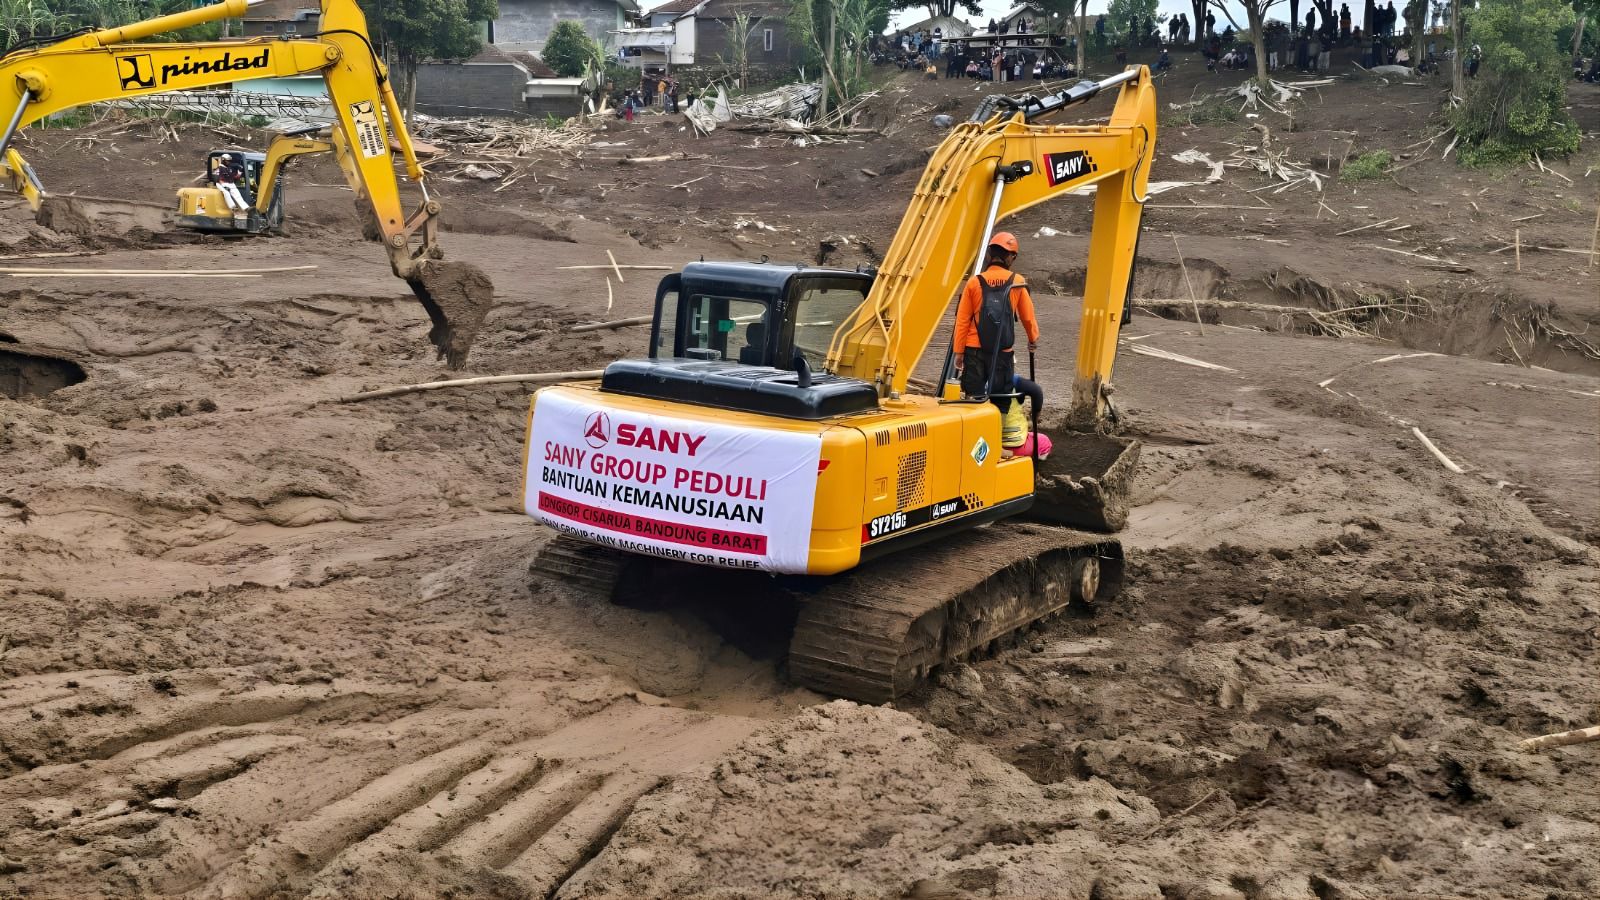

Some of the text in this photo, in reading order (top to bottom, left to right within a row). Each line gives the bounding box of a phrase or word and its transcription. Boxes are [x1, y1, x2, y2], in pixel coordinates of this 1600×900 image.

[161, 48, 270, 85] pindad
[1056, 155, 1084, 180] SANY
[616, 423, 706, 457] SANY
[544, 440, 767, 501] SANY GROUP PEDULI
[542, 465, 764, 524] BANTUAN KEMANUSIAAN
[940, 501, 958, 515] SANY
[540, 495, 761, 551] LONGSOR CISARUA BANDUNG BARAT
[560, 523, 589, 538] GROUP
[619, 538, 687, 559] MACHINERY
[690, 552, 715, 564] FOR
[718, 556, 760, 569] RELIEF
